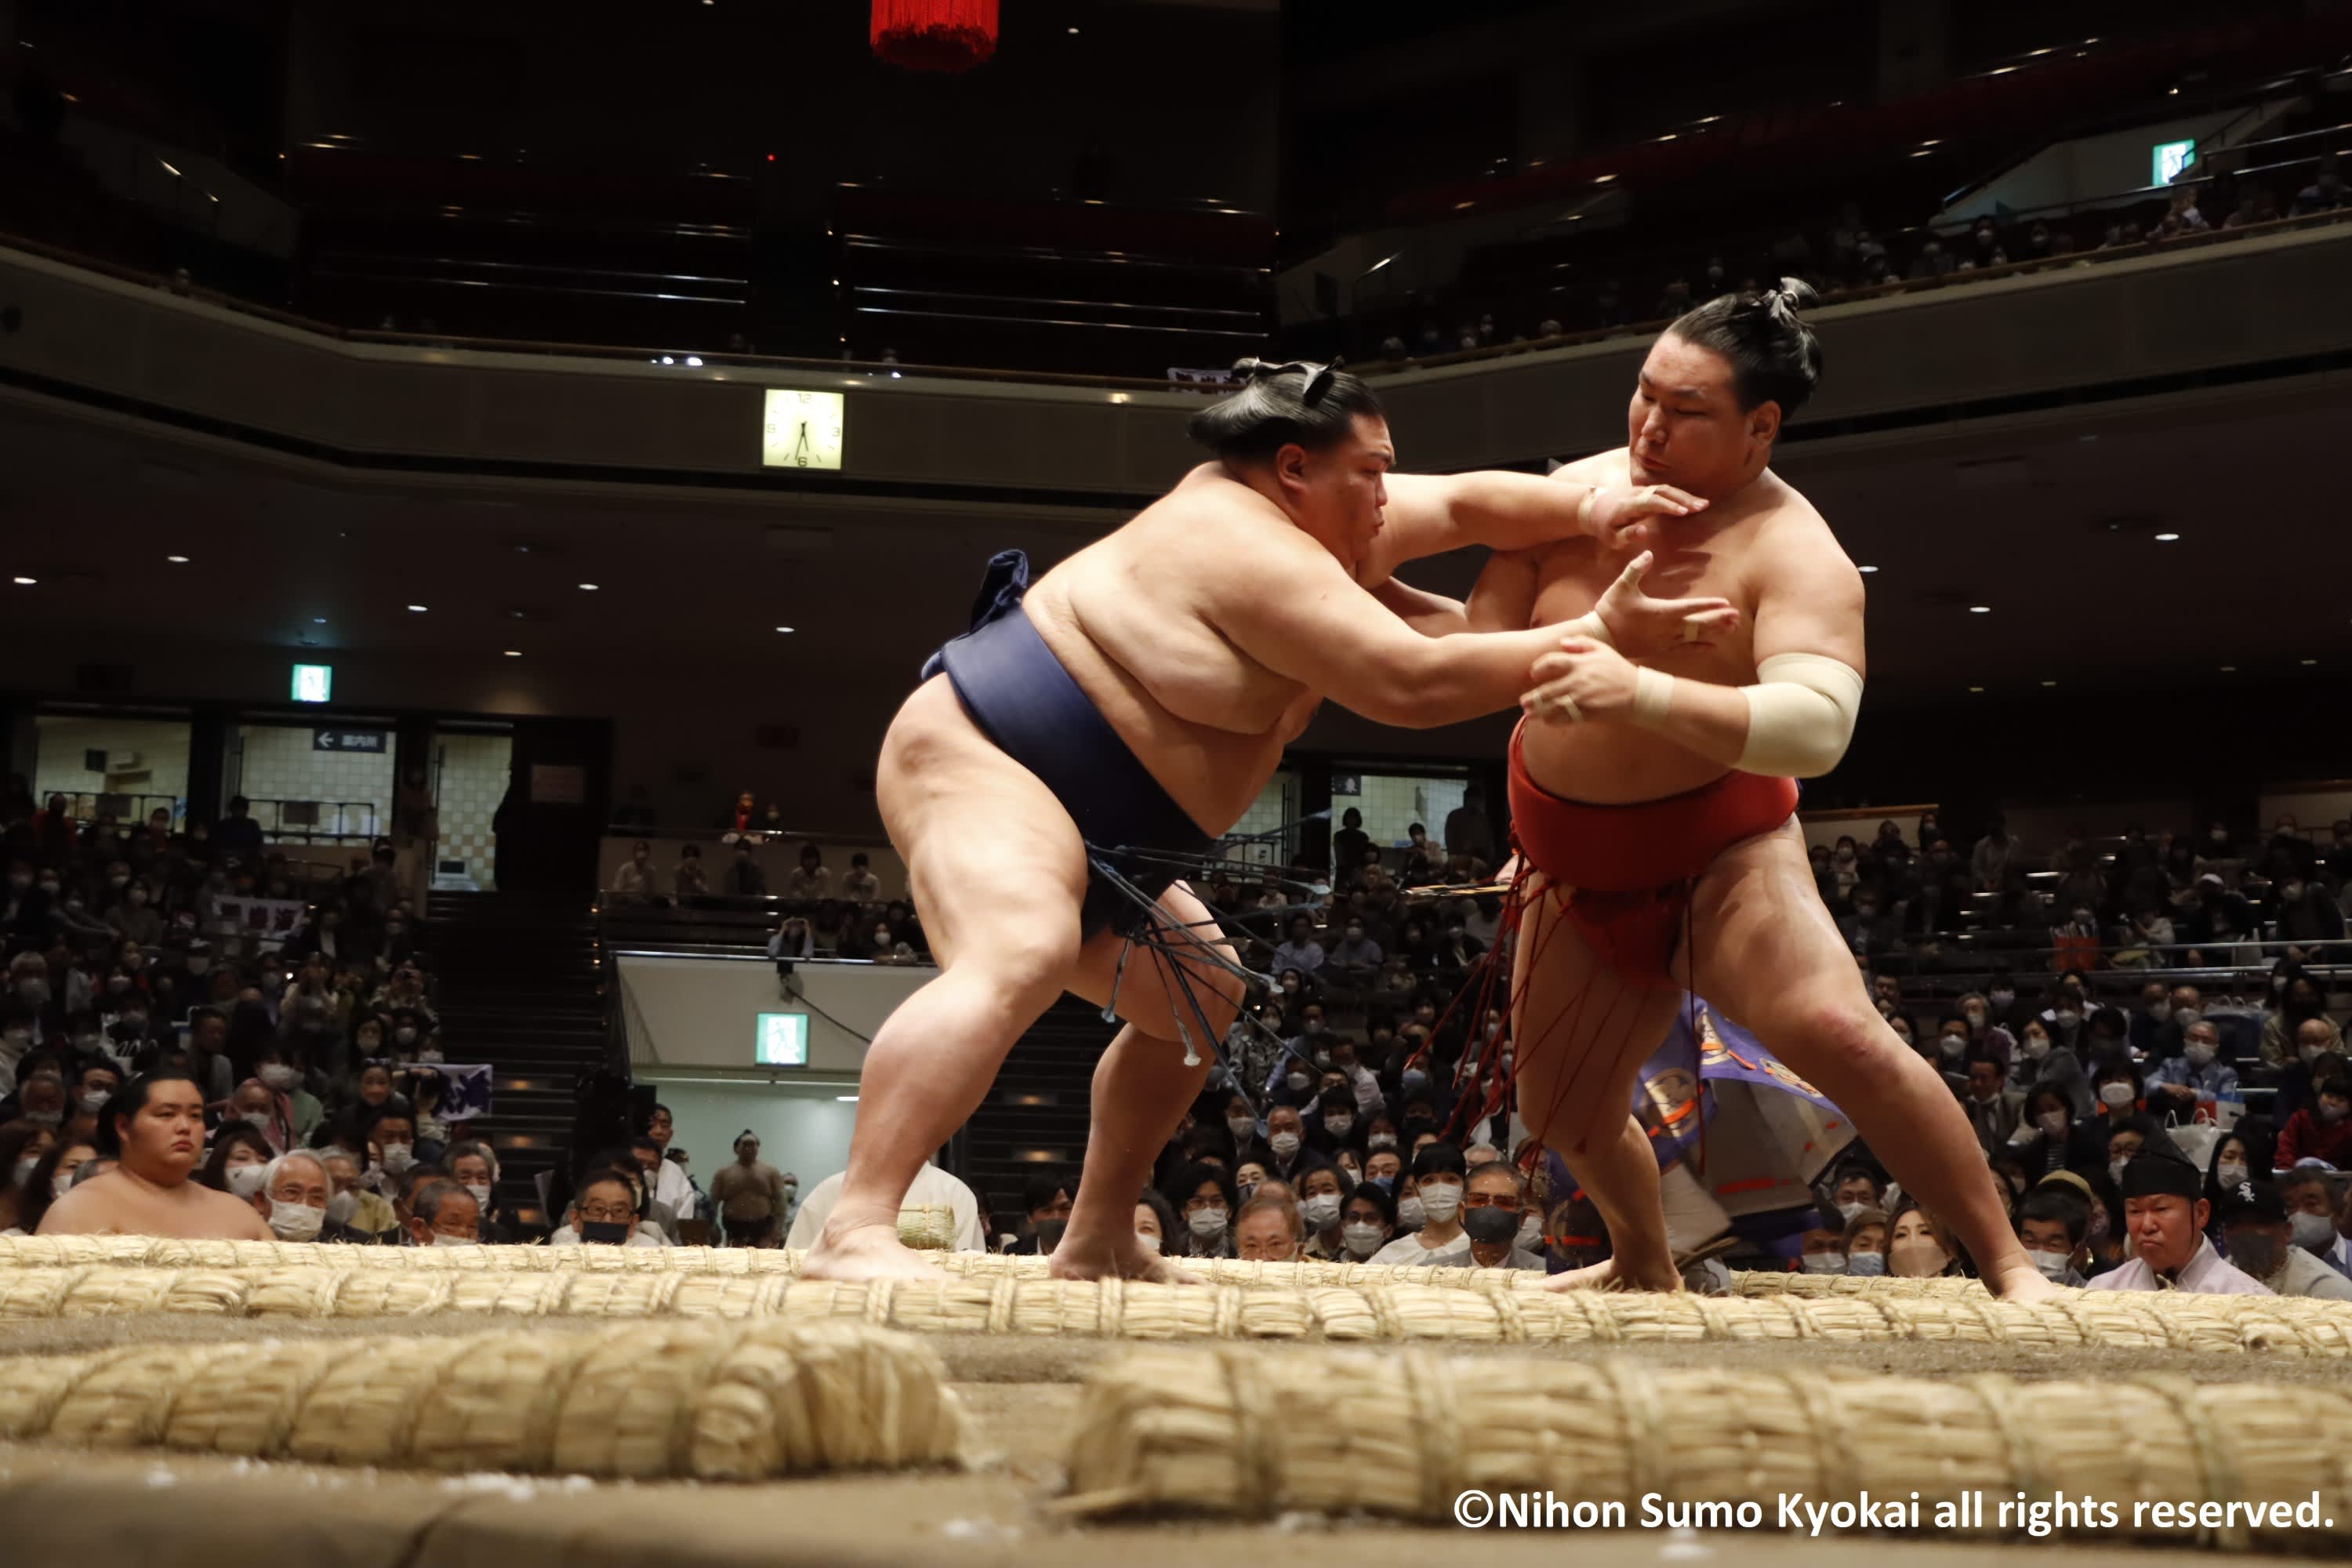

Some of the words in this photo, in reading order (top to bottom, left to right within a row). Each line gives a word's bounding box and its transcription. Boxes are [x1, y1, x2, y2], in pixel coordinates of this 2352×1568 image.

[797, 394, 812, 404] 12
[832, 427, 841, 437] 3
[797, 456, 808, 467] 6
